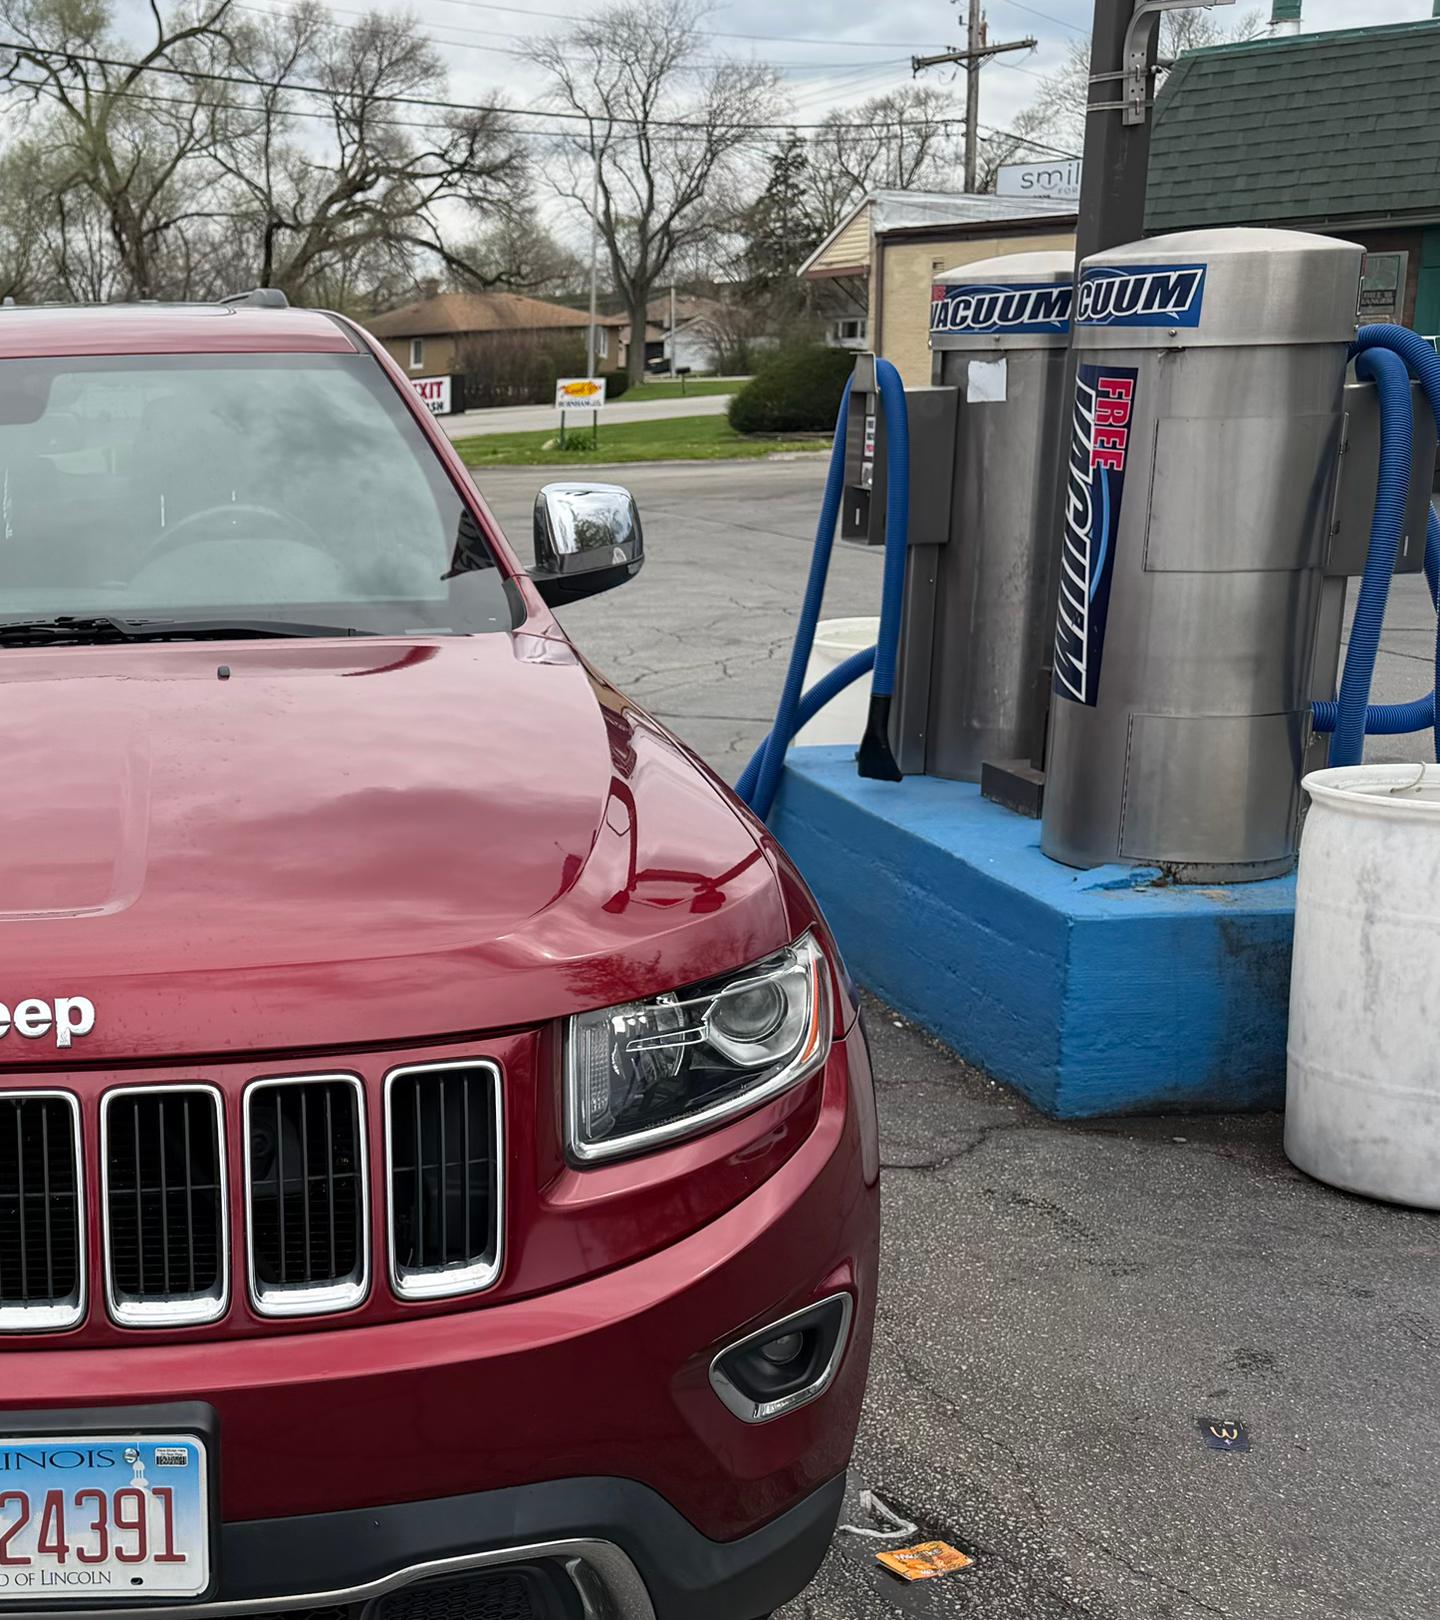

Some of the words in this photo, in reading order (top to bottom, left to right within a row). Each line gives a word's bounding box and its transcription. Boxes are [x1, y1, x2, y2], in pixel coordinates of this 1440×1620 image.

[1020, 161, 1080, 189] smil
[1076, 268, 1204, 322] CUUM
[412, 381, 443, 399] XIT
[1090, 377, 1135, 471] FREE
[14, 1573, 35, 1586] OF
[40, 1569, 112, 1586] LINCOLN
